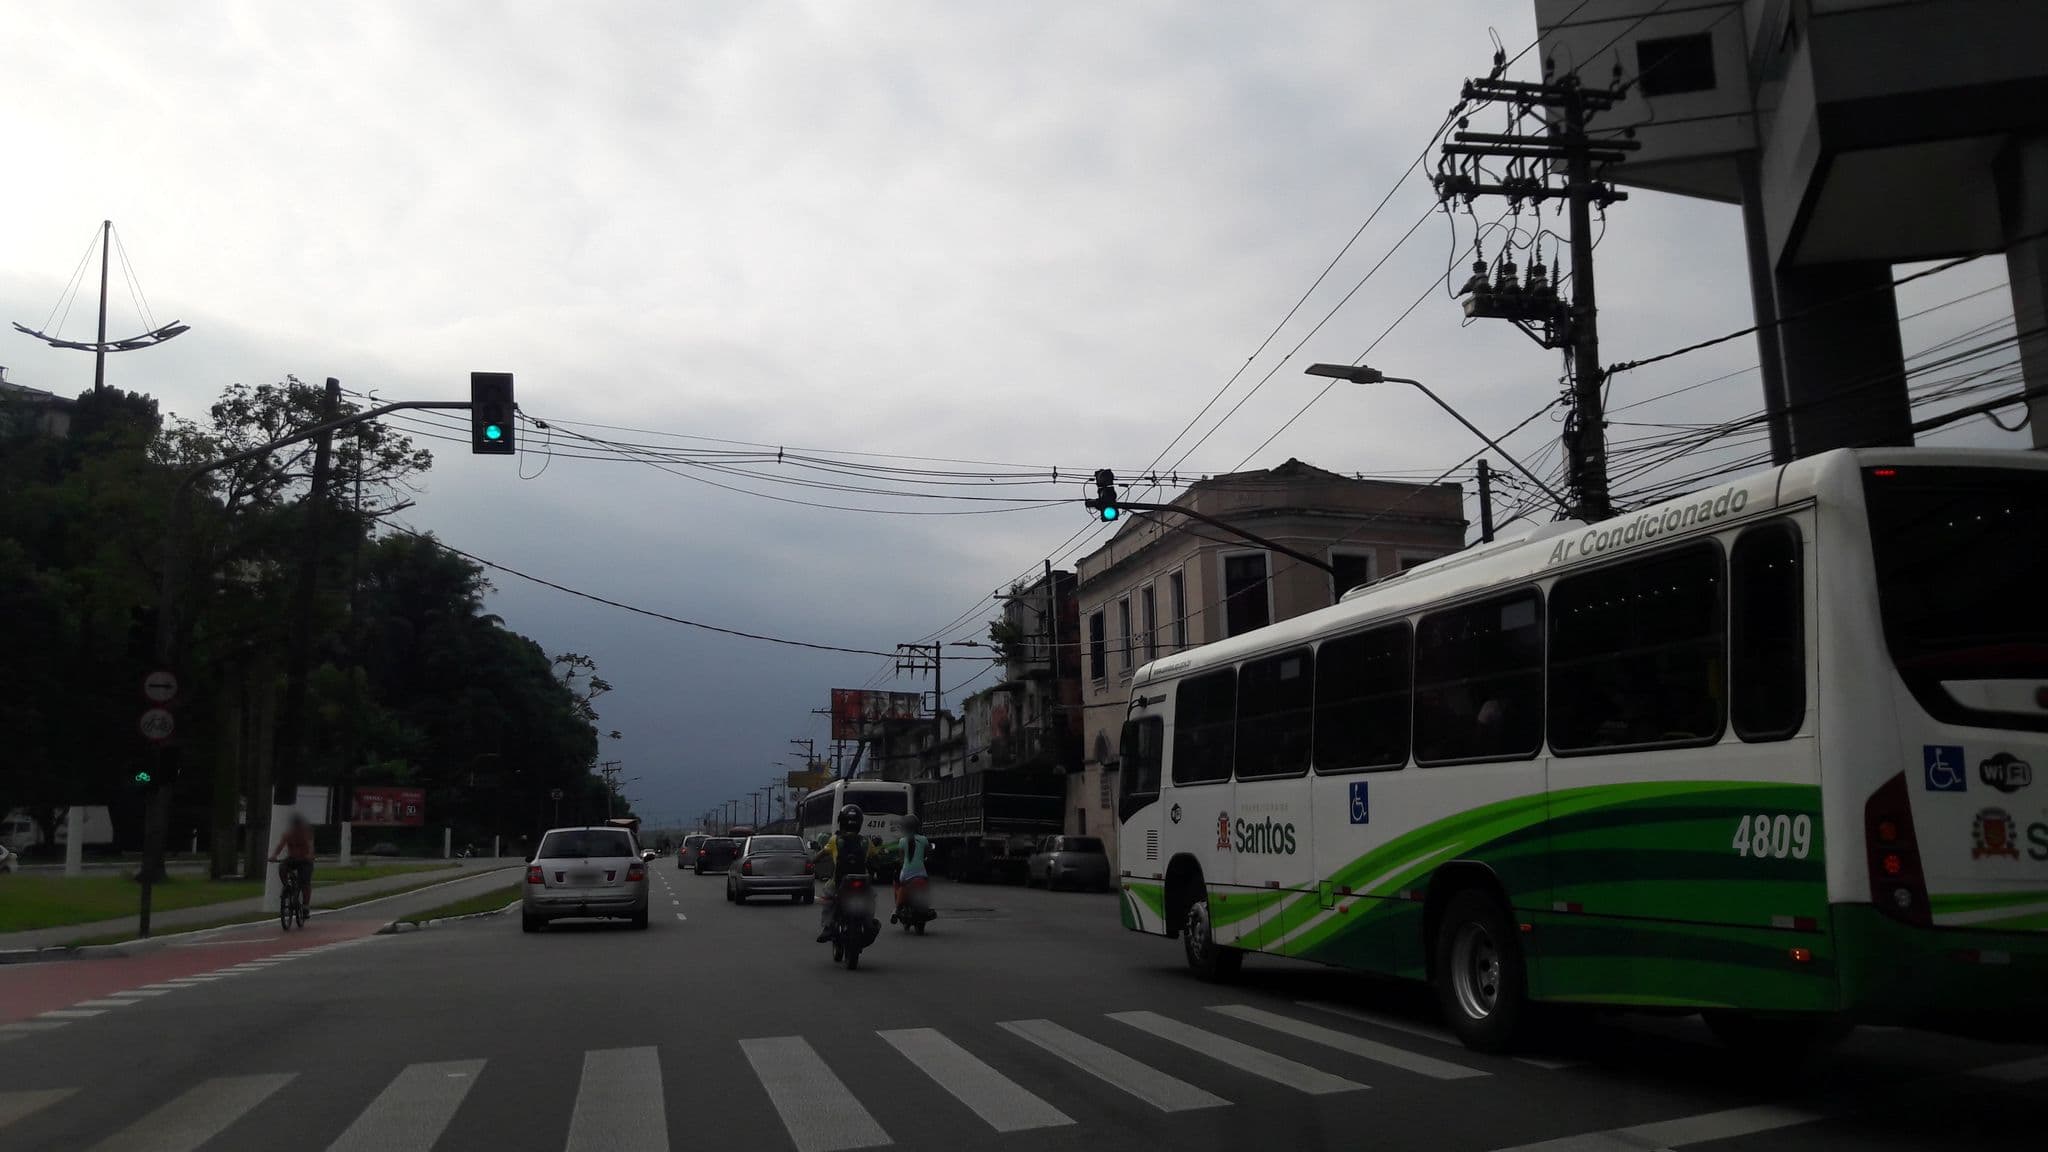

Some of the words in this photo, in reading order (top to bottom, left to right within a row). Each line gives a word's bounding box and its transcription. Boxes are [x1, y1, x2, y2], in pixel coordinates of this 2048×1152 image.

[1548, 538, 1574, 565] Ar
[1580, 486, 1748, 556] Condicionado
[1235, 815, 1296, 855] Santos
[1732, 813, 1812, 860] 4809
